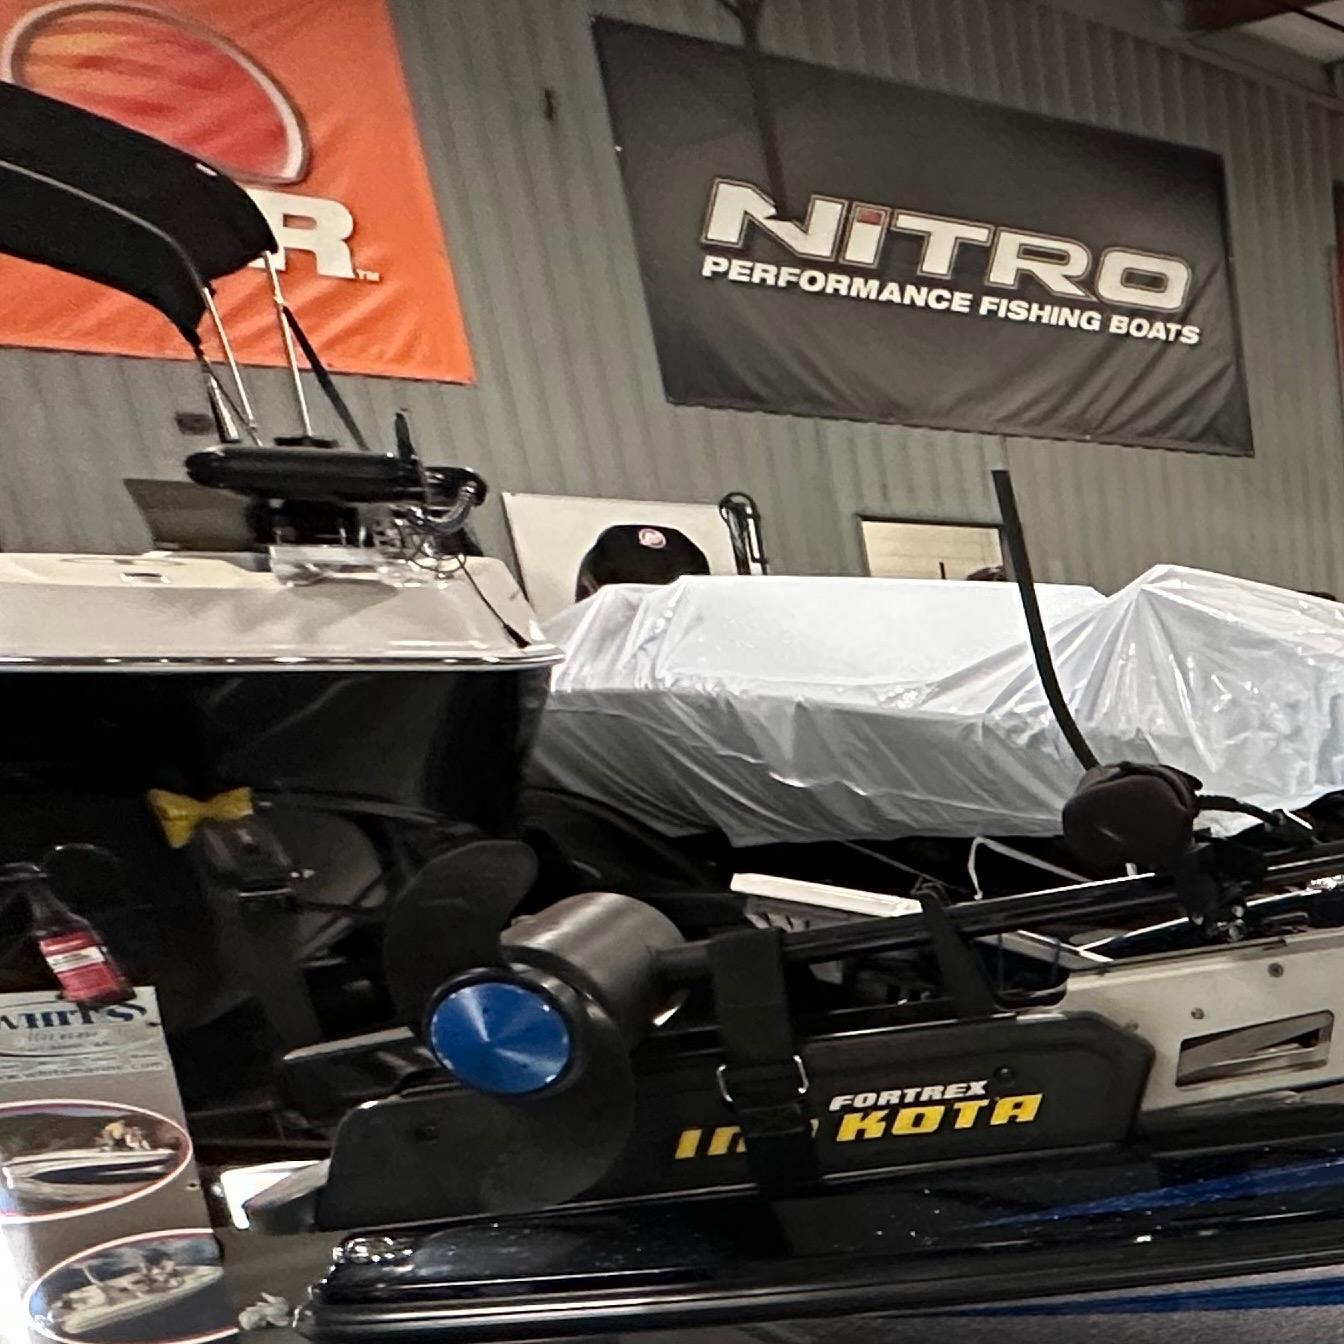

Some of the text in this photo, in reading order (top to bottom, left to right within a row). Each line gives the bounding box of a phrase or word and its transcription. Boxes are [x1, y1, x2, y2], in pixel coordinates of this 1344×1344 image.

[702, 255, 1200, 346] PERFORMANCE FISHING BOATS
[829, 1080, 989, 1112] FORTREX
[836, 1093, 1042, 1142] KOTA
